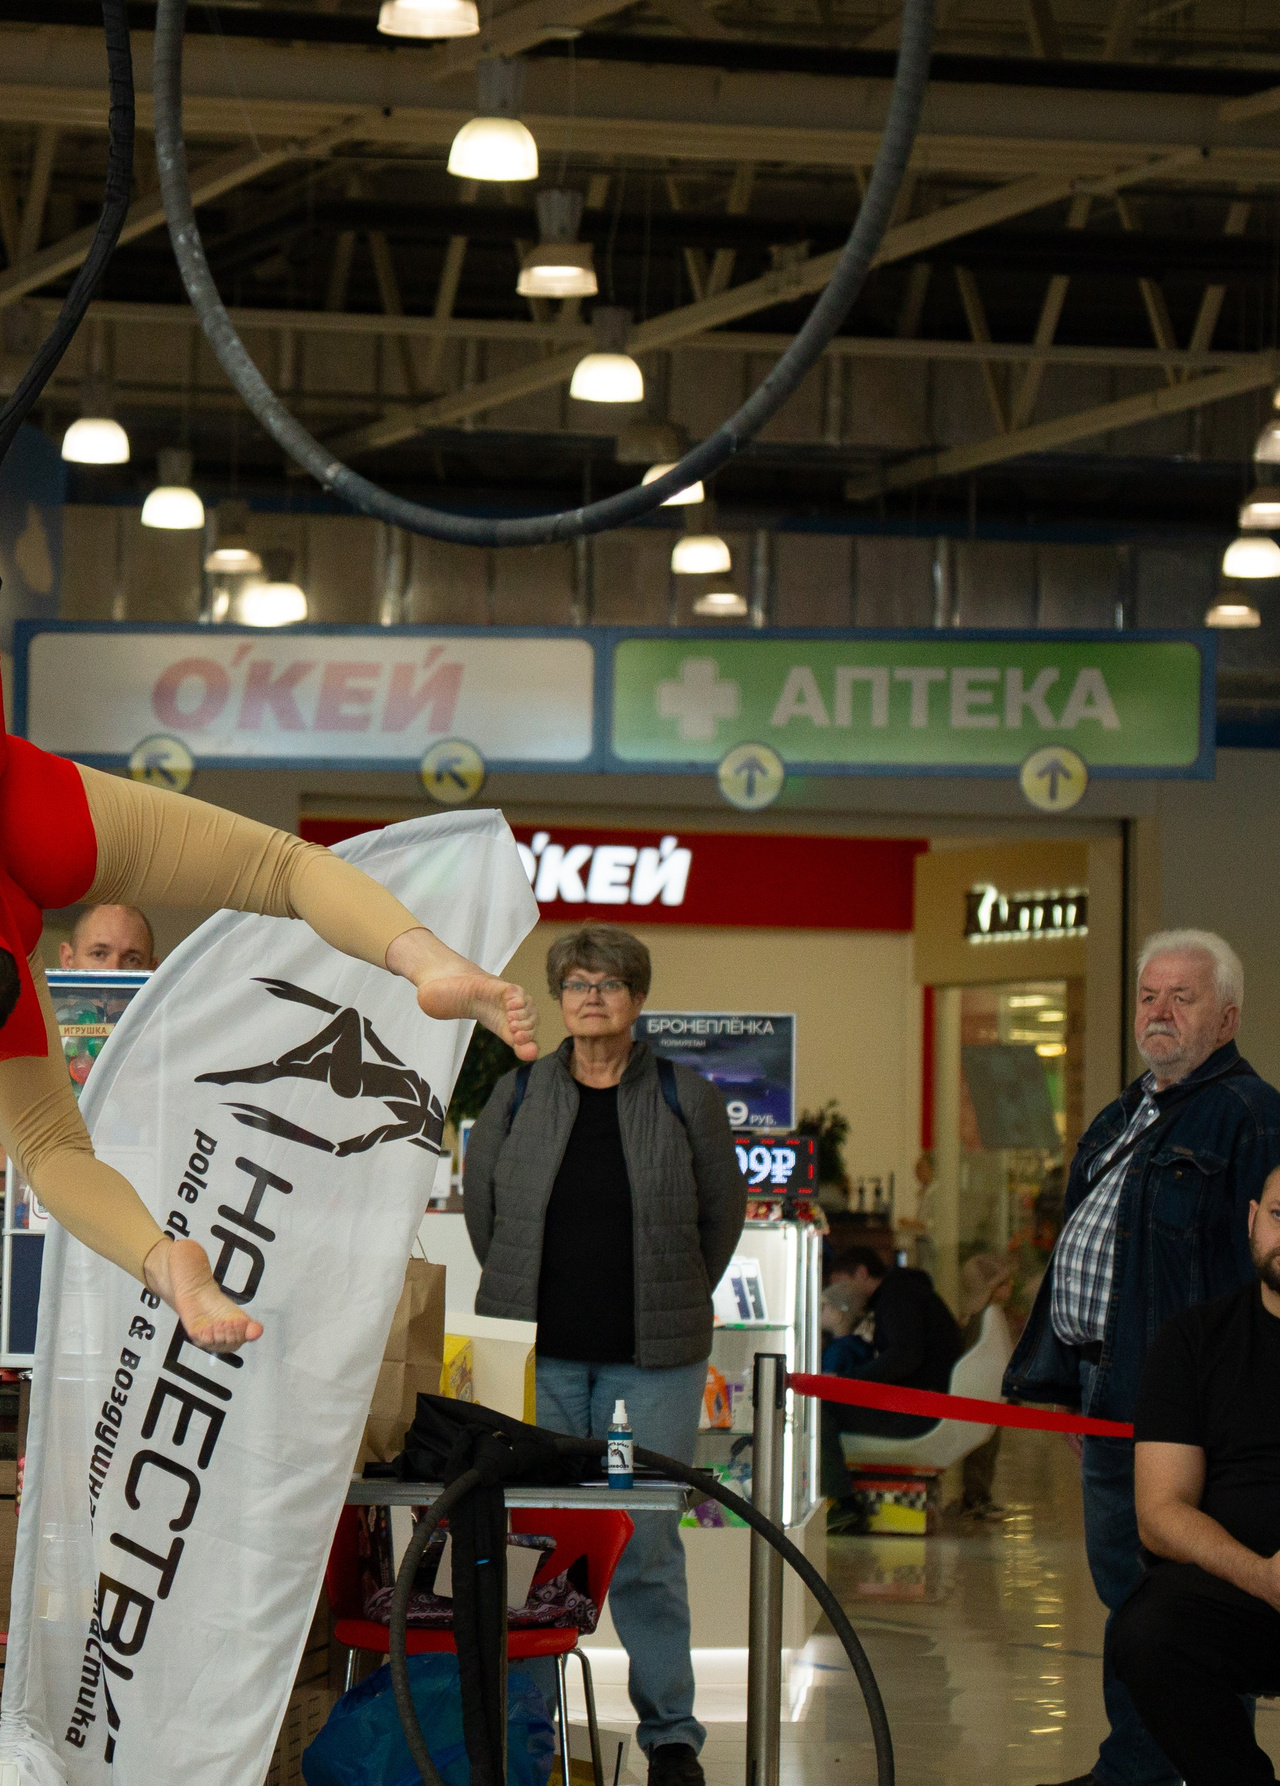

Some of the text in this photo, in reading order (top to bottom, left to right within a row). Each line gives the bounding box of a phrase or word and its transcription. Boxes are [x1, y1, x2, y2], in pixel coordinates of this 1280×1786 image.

[771, 665, 1121, 730] АПТЕКА
[63, 1026, 107, 1035] ИГРУШКА
[646, 1017, 775, 1036] БРОНЕПЛЁНКА
[177, 1128, 219, 1204] pole
[128, 1315, 156, 1341] &
